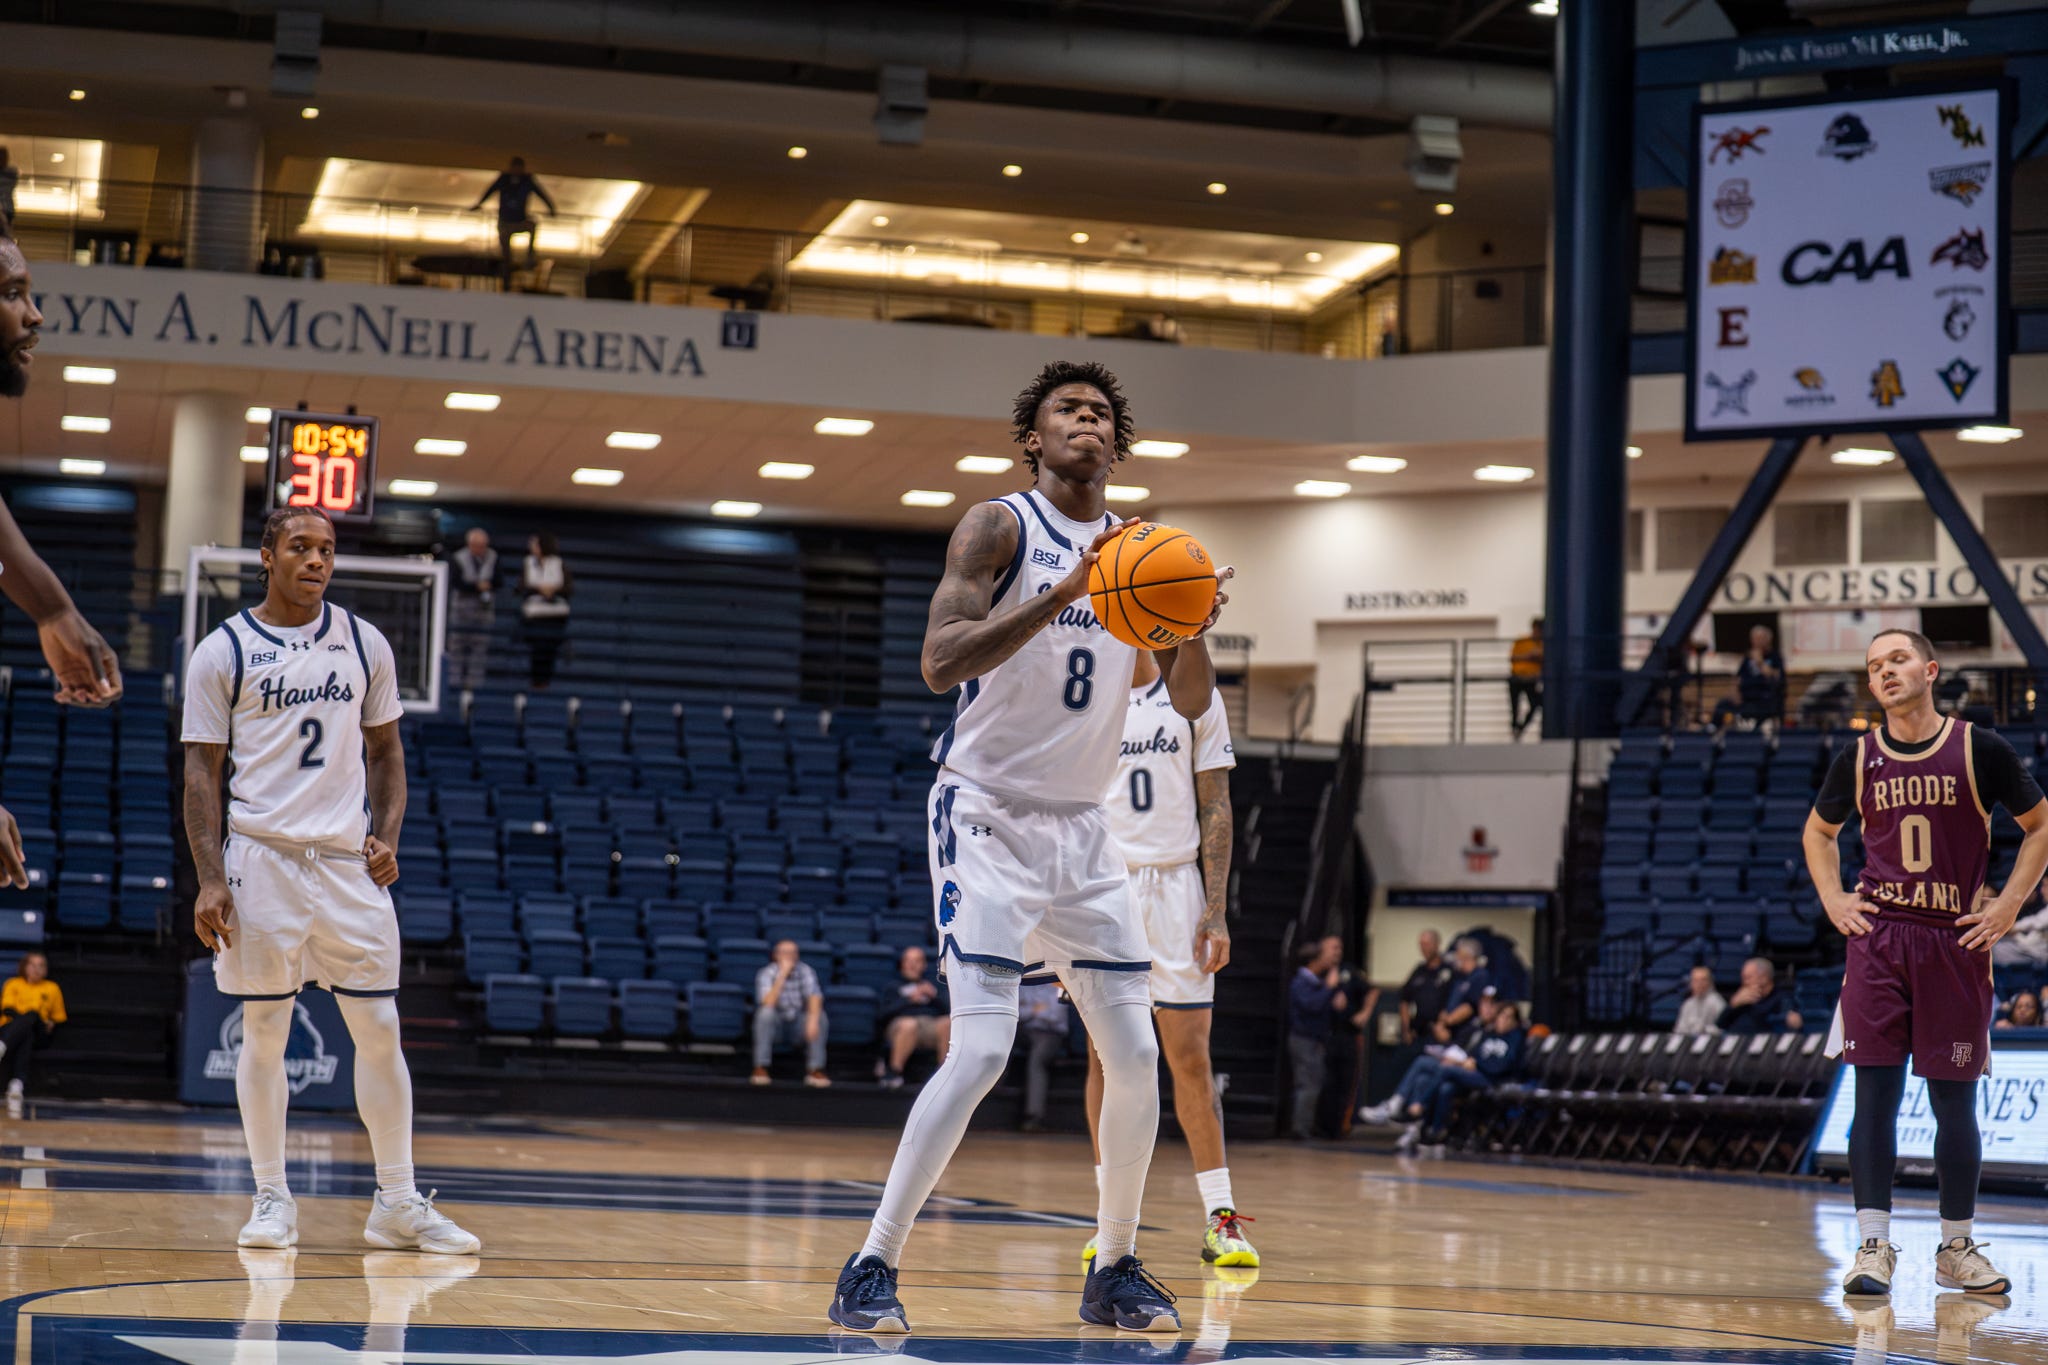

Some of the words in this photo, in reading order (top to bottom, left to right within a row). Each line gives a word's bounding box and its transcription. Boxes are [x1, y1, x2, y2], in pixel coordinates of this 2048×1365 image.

[1781, 236, 1912, 286] CAA
[154, 290, 219, 344] A.
[504, 314, 706, 377] ARENA
[1717, 307, 1749, 350] E
[293, 423, 367, 457] 10:54
[289, 453, 356, 511] 30
[1032, 548, 1061, 566] BSI
[1345, 590, 1467, 611] RESTROOMS
[1723, 563, 2048, 606] ONCESSIOS
[251, 651, 276, 665] BSI
[1062, 645, 1096, 712] 8
[260, 670, 354, 712] Hawks
[299, 718, 325, 770] 2
[1120, 725, 1181, 757] awks
[1129, 767, 1154, 813] 0
[1873, 774, 1957, 812] RHODE
[1900, 814, 1932, 873] 0
